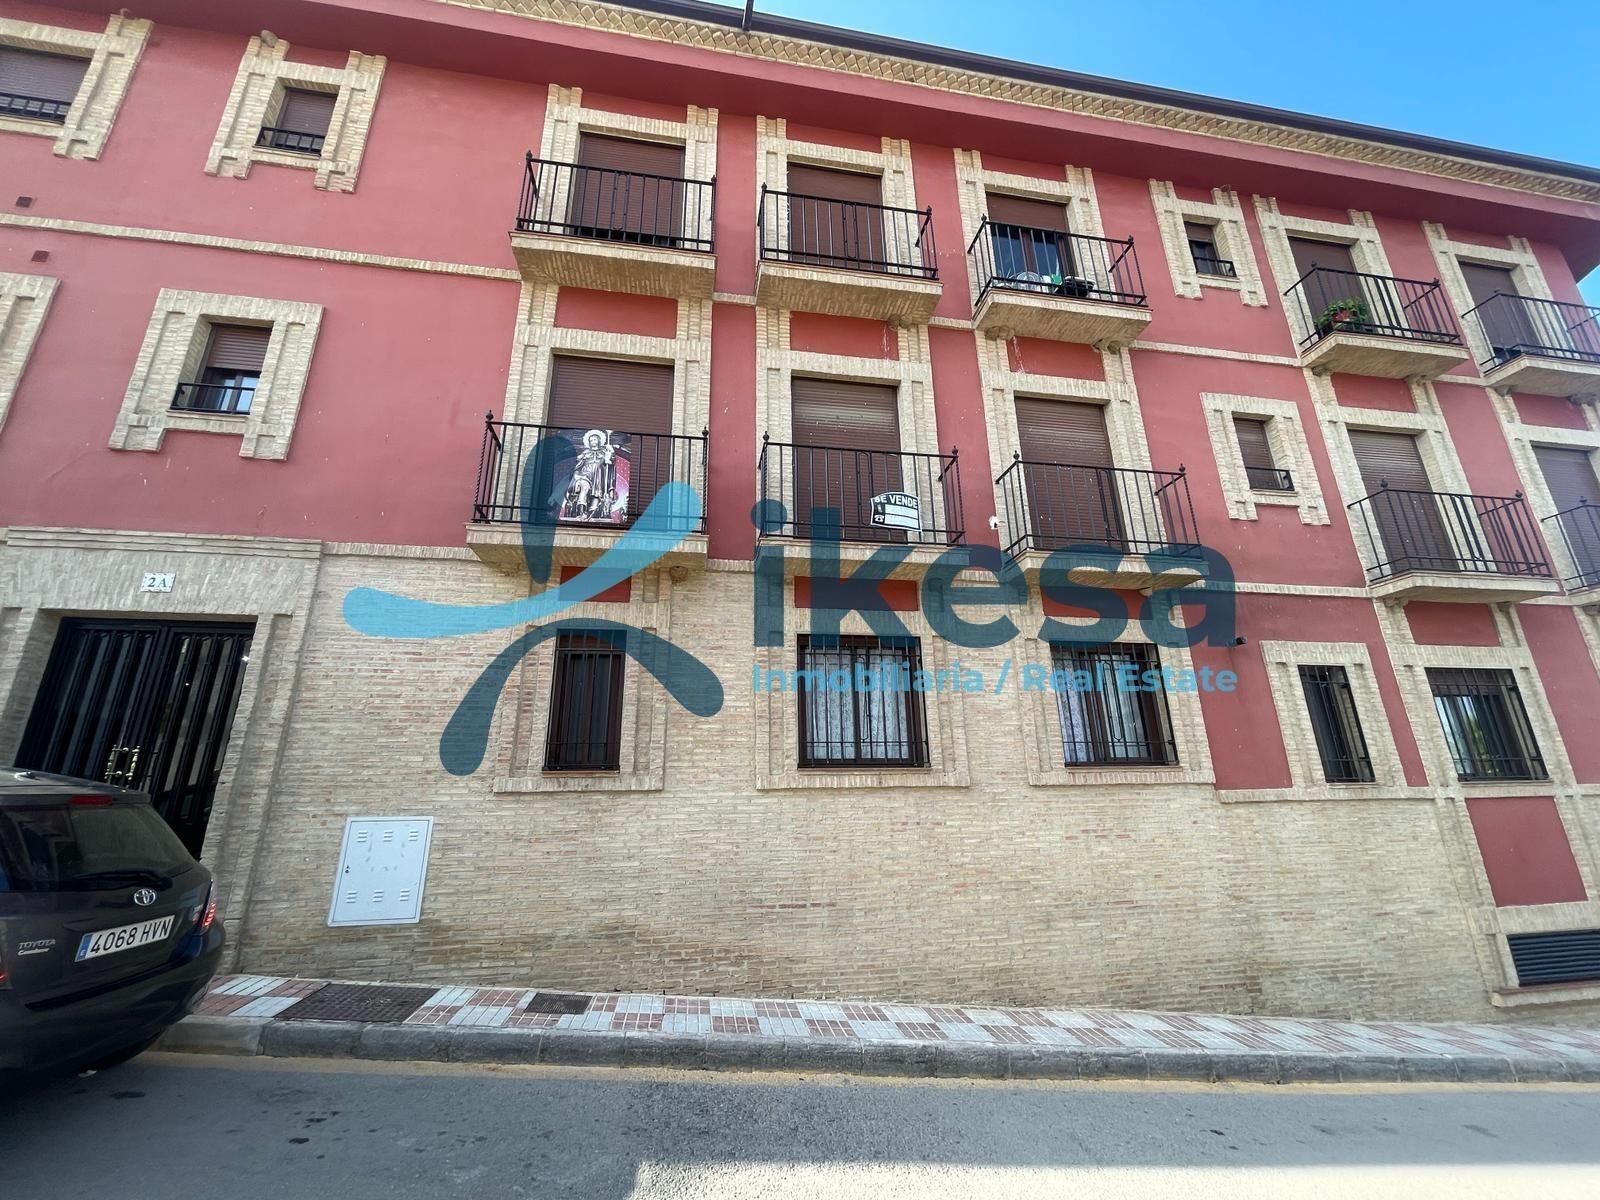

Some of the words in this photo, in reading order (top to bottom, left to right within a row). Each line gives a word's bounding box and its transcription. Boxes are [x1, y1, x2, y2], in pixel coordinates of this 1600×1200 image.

[874, 495, 887, 503] SE
[889, 495, 918, 508] VENDE
[90, 927, 138, 953] 4068
[140, 919, 172, 942] HVN
[18, 939, 56, 949] TOYOTA
